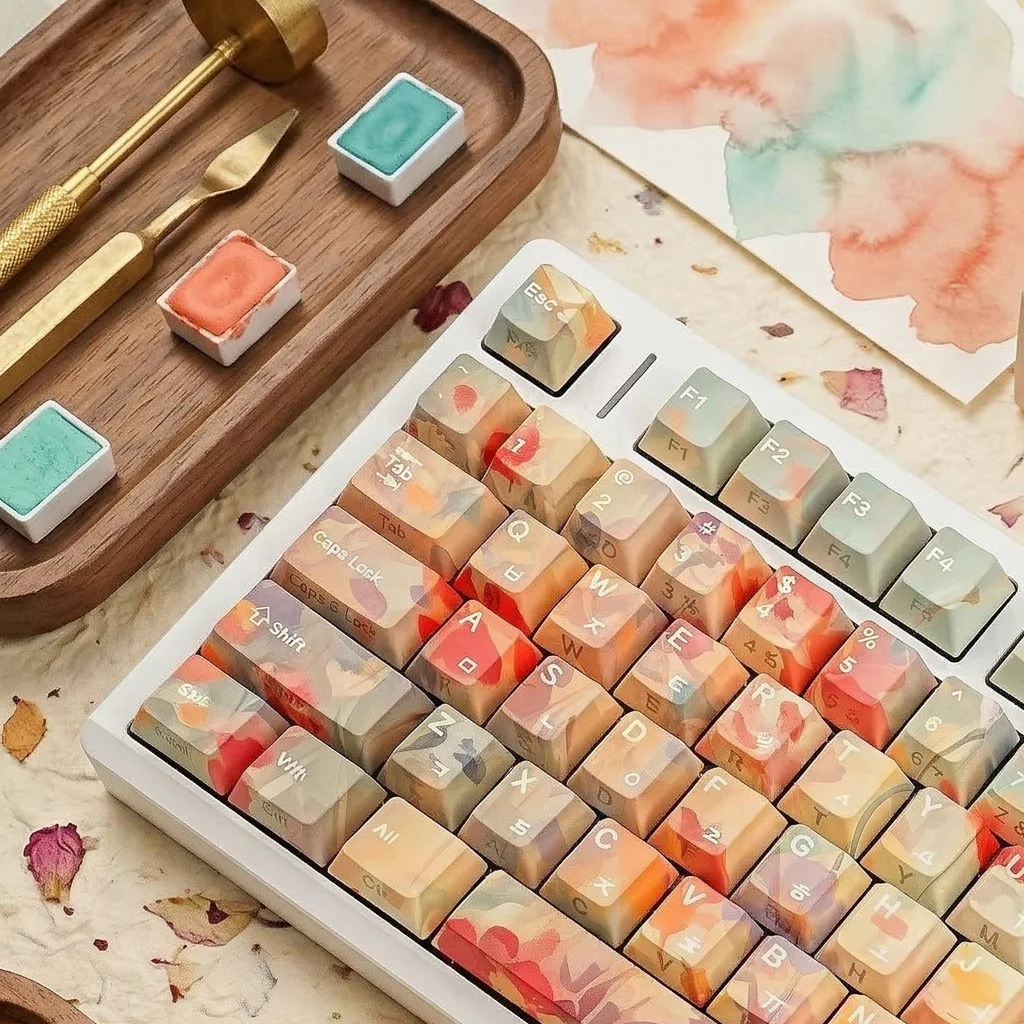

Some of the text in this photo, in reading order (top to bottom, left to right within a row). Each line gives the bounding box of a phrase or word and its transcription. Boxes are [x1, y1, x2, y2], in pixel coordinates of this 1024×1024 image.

[680, 386, 708, 410] F1
[510, 438, 526, 454] 1
[668, 438, 687, 461] F1
[760, 437, 790, 465] F2
[384, 454, 413, 482] Tab
[614, 469, 634, 486] @
[592, 494, 611, 511] 2
[841, 491, 871, 517] F3
[379, 512, 406, 539] Tab
[507, 520, 529, 543] Q
[313, 531, 348, 560] Caps
[827, 543, 852, 569] F4
[925, 547, 955, 573] F4
[589, 570, 618, 597] W
[661, 582, 674, 600] 3
[459, 611, 483, 632] A
[562, 634, 583, 660] W
[668, 626, 695, 652] E
[744, 640, 756, 653] 4
[858, 628, 880, 650] %
[540, 663, 563, 685] S
[838, 656, 858, 673] 5
[752, 683, 775, 709] R
[427, 711, 457, 737] Z
[621, 719, 647, 743] D
[925, 716, 942, 732] 6
[838, 740, 860, 761] T
[912, 752, 924, 766] 6
[511, 769, 538, 794] X
[703, 775, 728, 792] F
[814, 806, 827, 826] T
[921, 794, 942, 817] Y
[594, 827, 619, 850] C
[790, 834, 815, 857] G
[898, 865, 913, 884] Y
[682, 884, 707, 906] V
[872, 893, 901, 919] H
[657, 951, 674, 972] V
[761, 942, 788, 968] B
[959, 956, 983, 973] J
